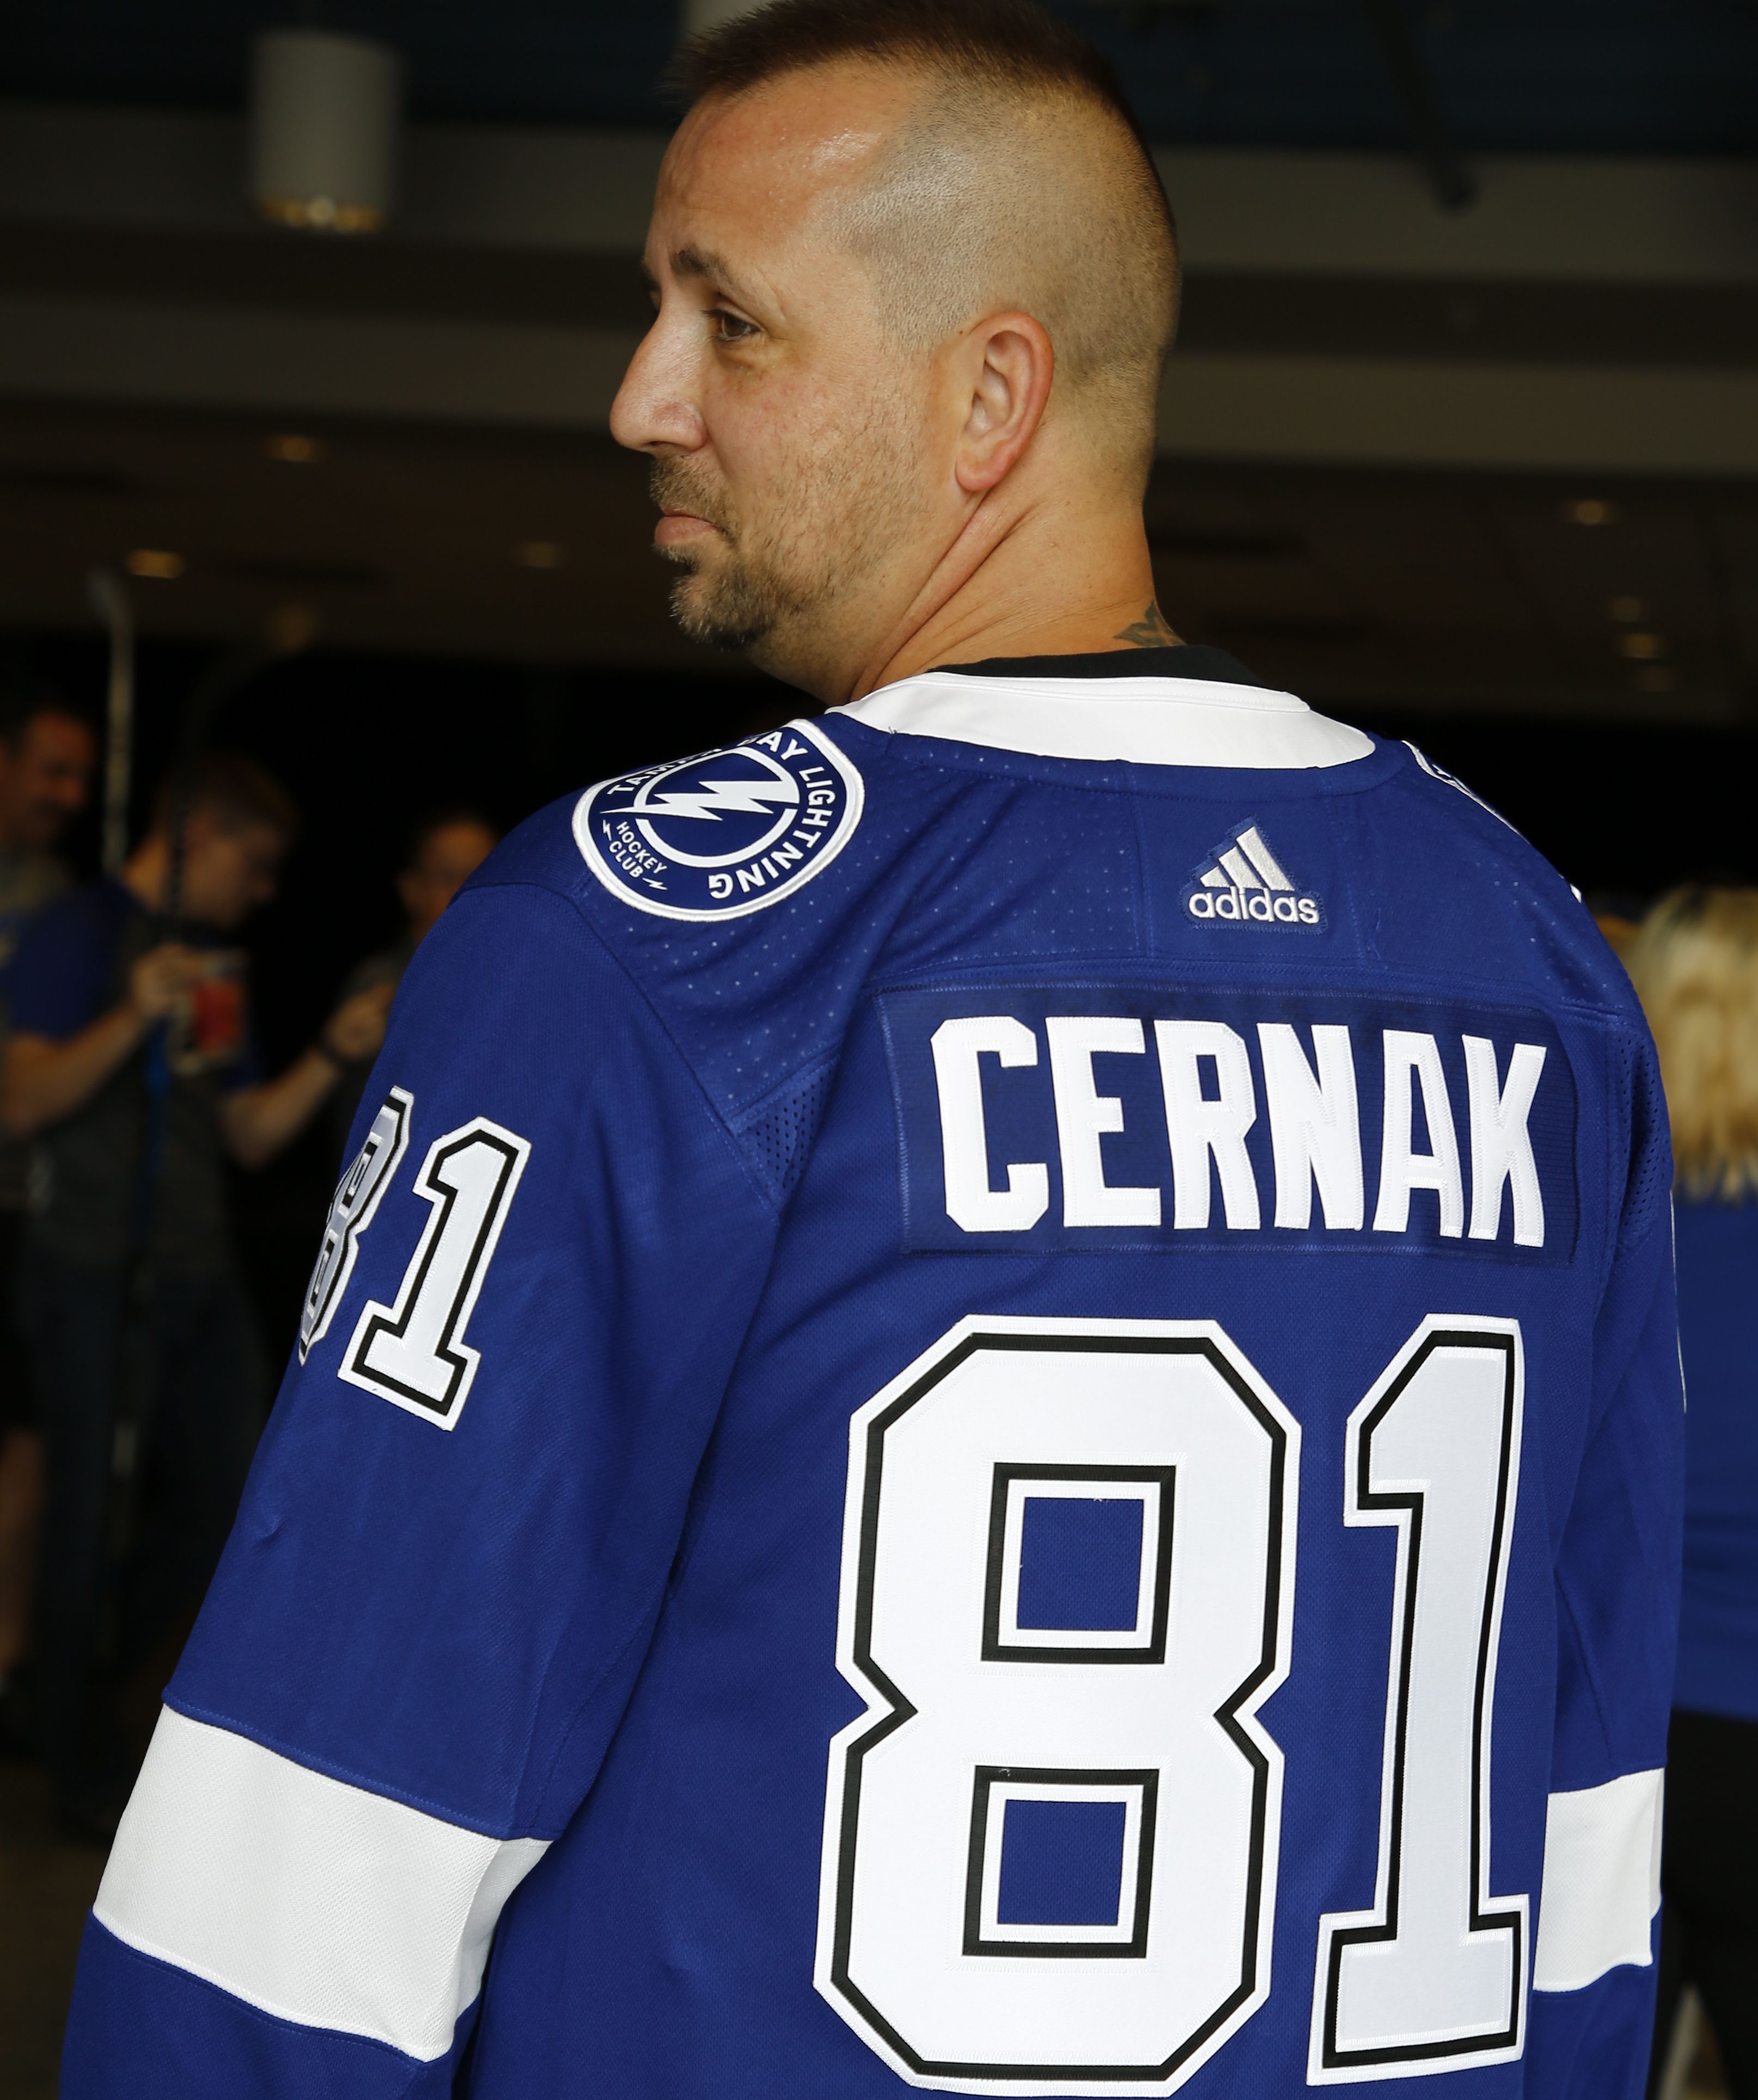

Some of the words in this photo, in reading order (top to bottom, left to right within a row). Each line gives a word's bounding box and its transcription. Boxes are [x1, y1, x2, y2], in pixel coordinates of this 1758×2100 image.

[608, 841, 644, 879] CLUB
[616, 821, 667, 874] HOCKEY
[708, 766, 837, 900] LIGHTNING
[1188, 885, 1320, 925] adidas
[930, 1015, 1547, 1248] CERNAK
[811, 1313, 1531, 2098] 81
